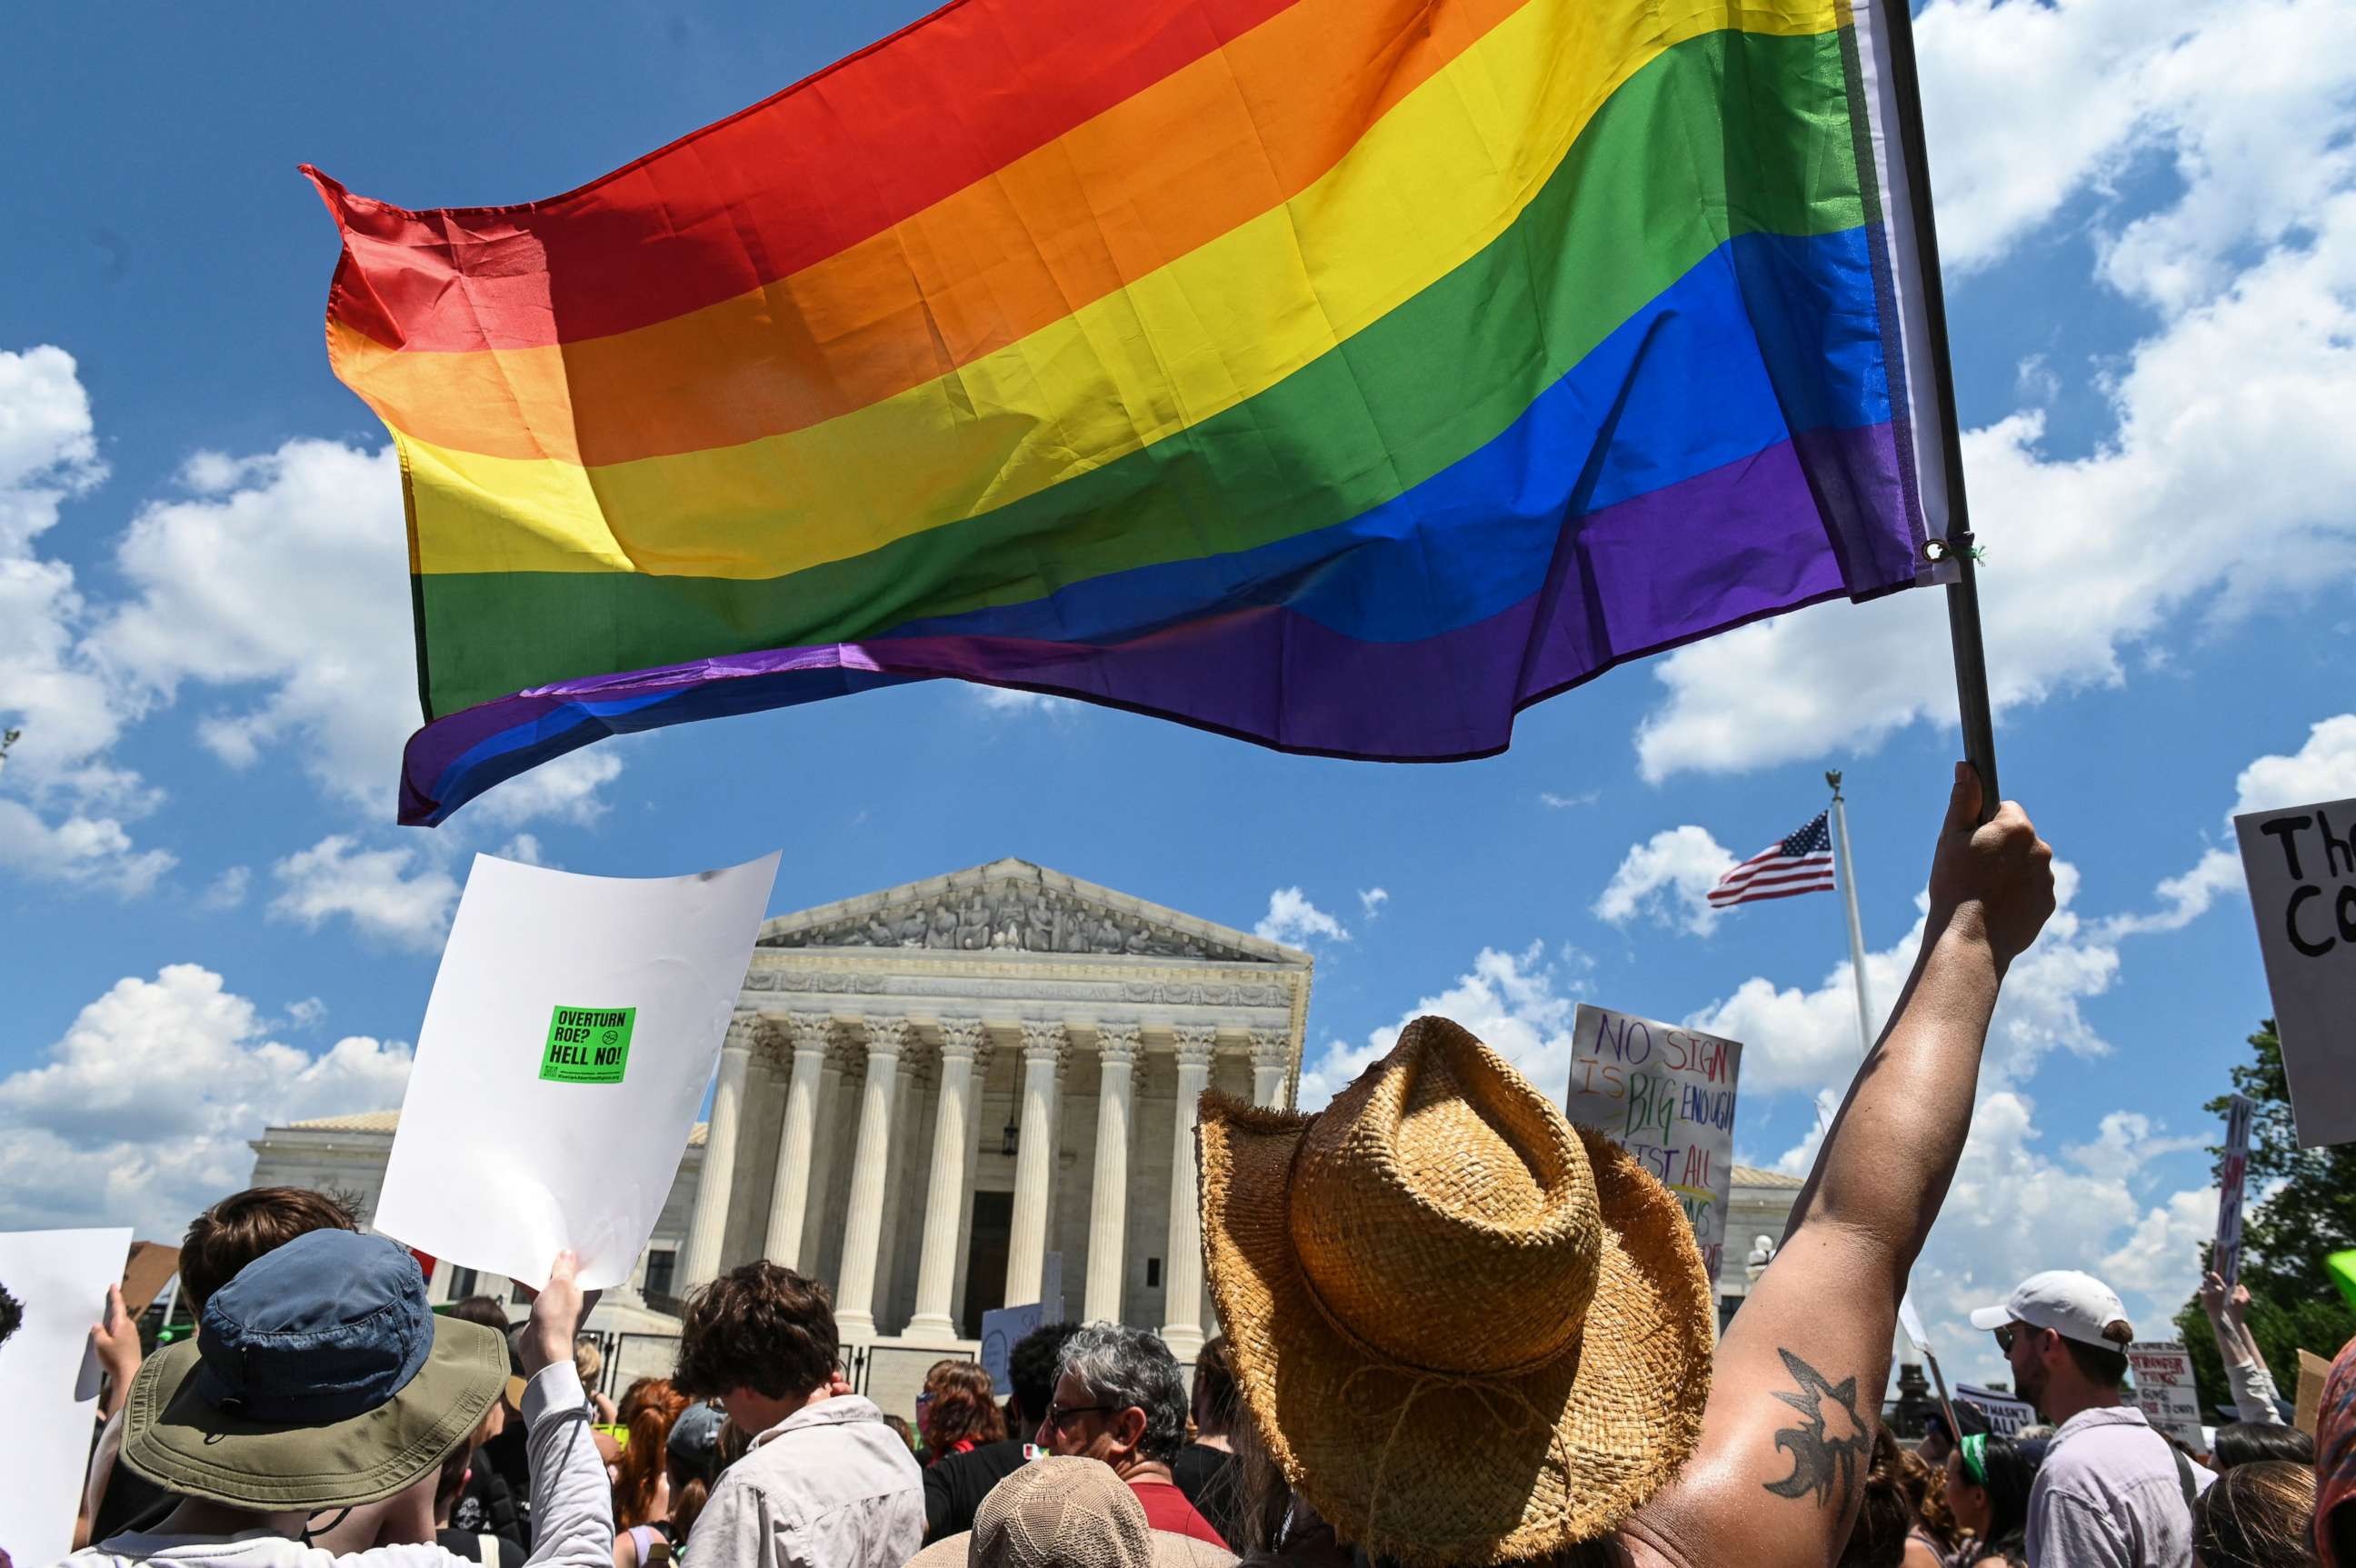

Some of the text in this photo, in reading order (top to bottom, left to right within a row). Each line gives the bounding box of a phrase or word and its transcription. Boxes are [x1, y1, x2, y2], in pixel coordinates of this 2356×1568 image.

[2260, 810, 2356, 880] Th
[554, 1026, 591, 1044] ROE?
[558, 1010, 627, 1028] OVERTURN
[549, 1044, 624, 1066] HELL NO!
[1594, 1014, 1728, 1084] NO SIGN
[1578, 1057, 1736, 1145] IS BIG ENOUGH
[1682, 1144, 1712, 1188] ALL
